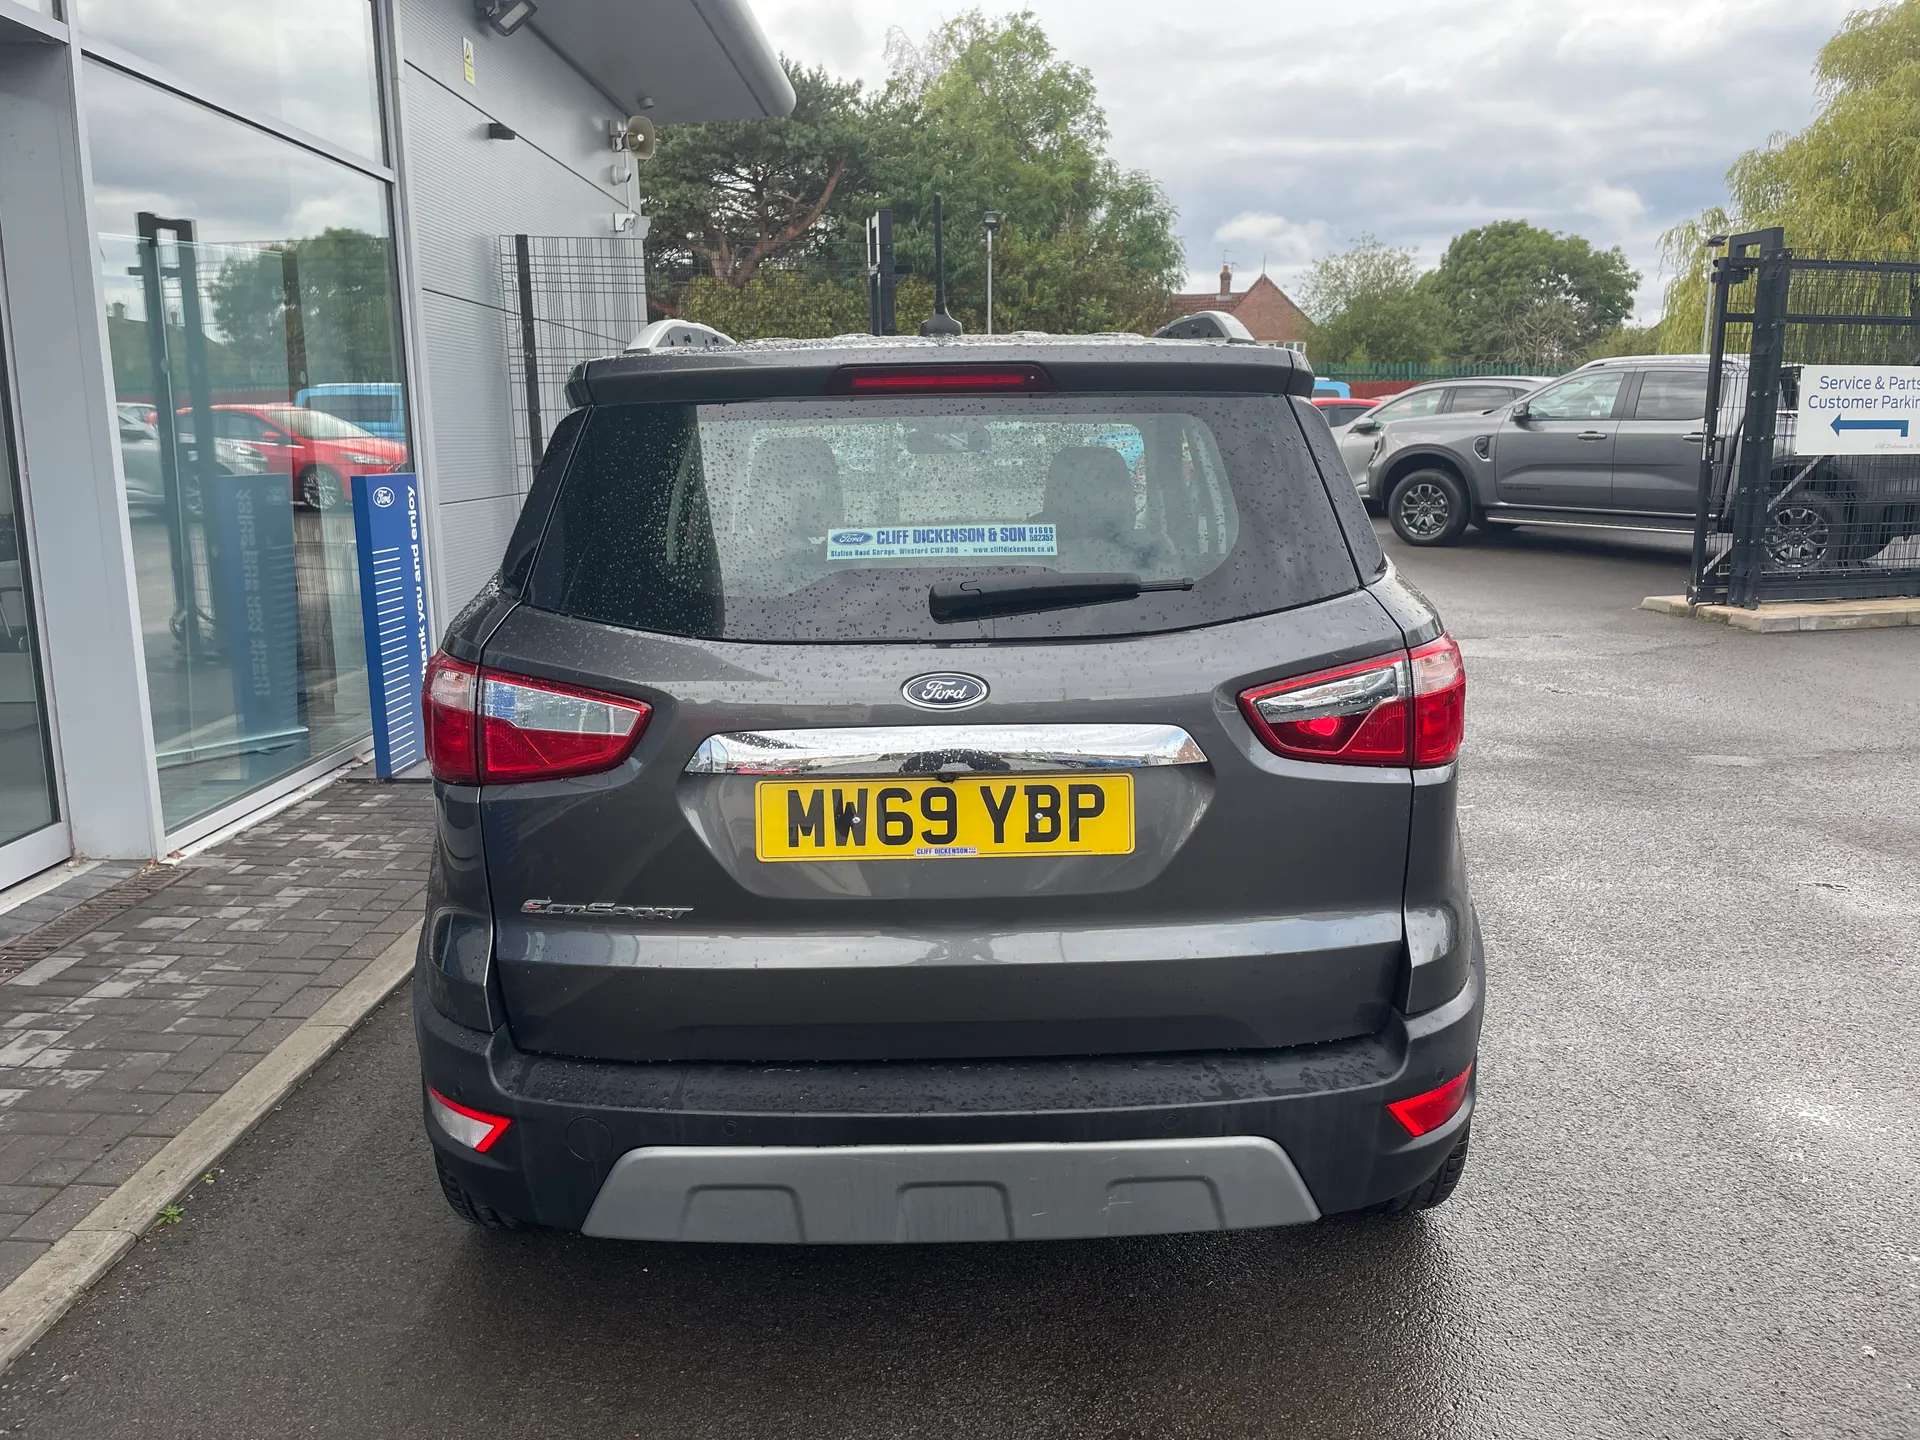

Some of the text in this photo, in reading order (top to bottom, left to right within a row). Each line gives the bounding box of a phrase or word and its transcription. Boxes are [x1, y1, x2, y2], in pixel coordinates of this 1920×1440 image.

[1820, 375, 1920, 390] Service & Parts
[1808, 394, 1878, 409] Customer
[876, 527, 1027, 545] CLIFF DICKENSON & SON
[407, 486, 428, 681] hank you and enjoy
[921, 680, 968, 700] Ford
[787, 783, 1106, 849] MW69 YBP
[934, 847, 968, 855] DICKENSON
